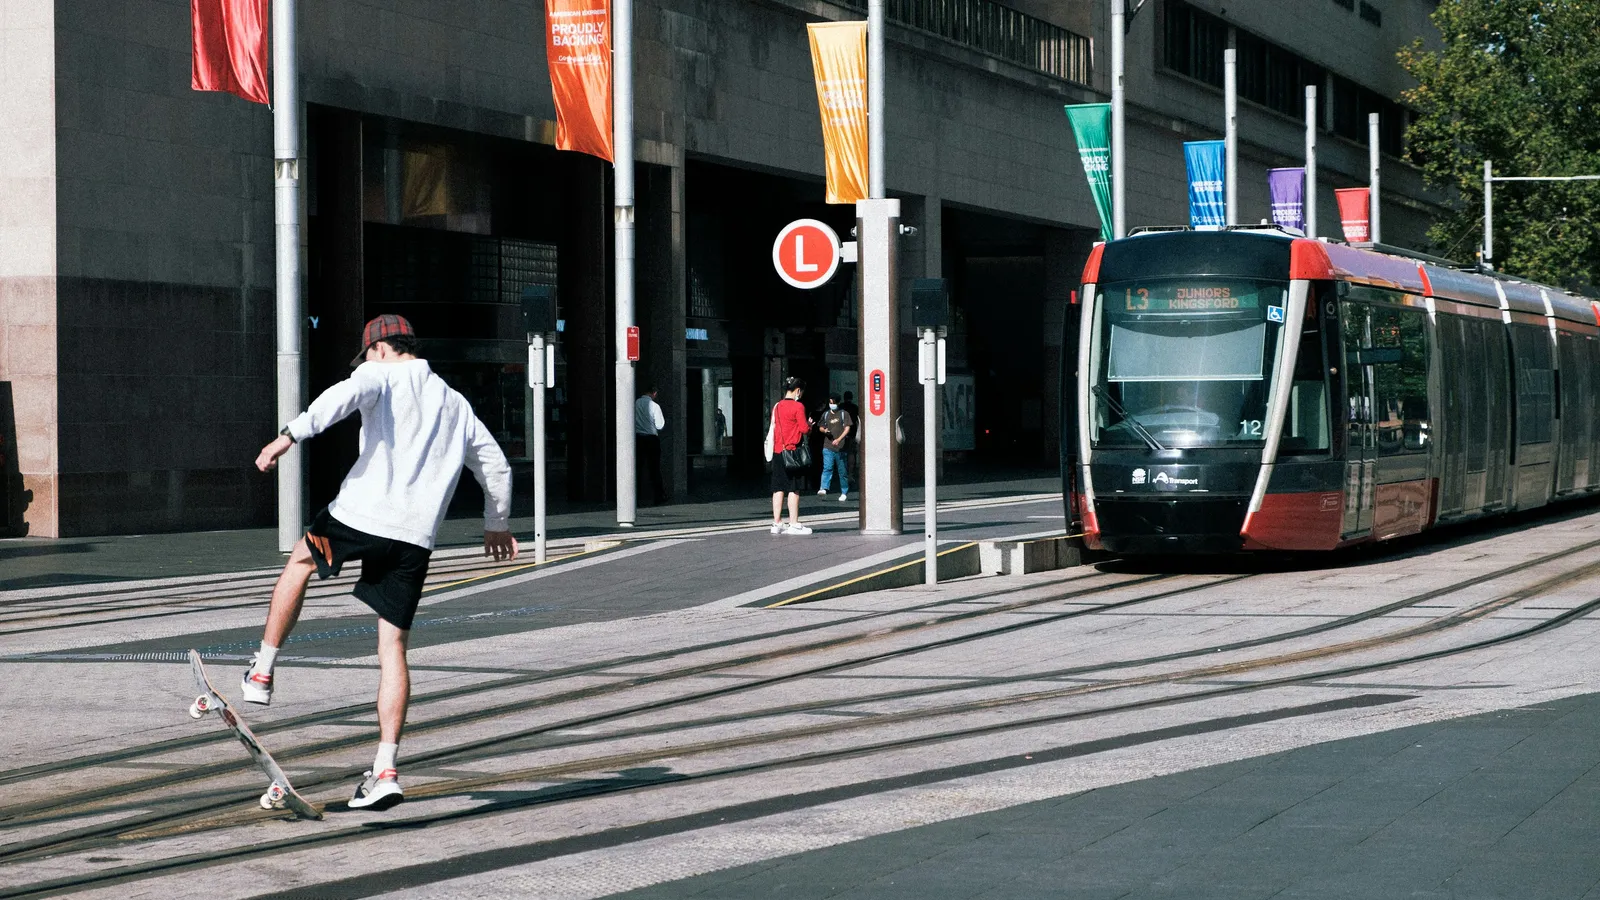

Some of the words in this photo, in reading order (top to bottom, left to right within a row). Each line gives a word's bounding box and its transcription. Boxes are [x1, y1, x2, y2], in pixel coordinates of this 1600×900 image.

[551, 21, 604, 35] PROUDLY
[552, 34, 603, 46] BACKING
[795, 234, 818, 272] L
[1126, 287, 1149, 310] L3
[1177, 287, 1230, 299] JUNIORS
[1169, 297, 1239, 309] KINGSFORD
[1239, 420, 1262, 436] 12
[1169, 477, 1199, 485] Transport
